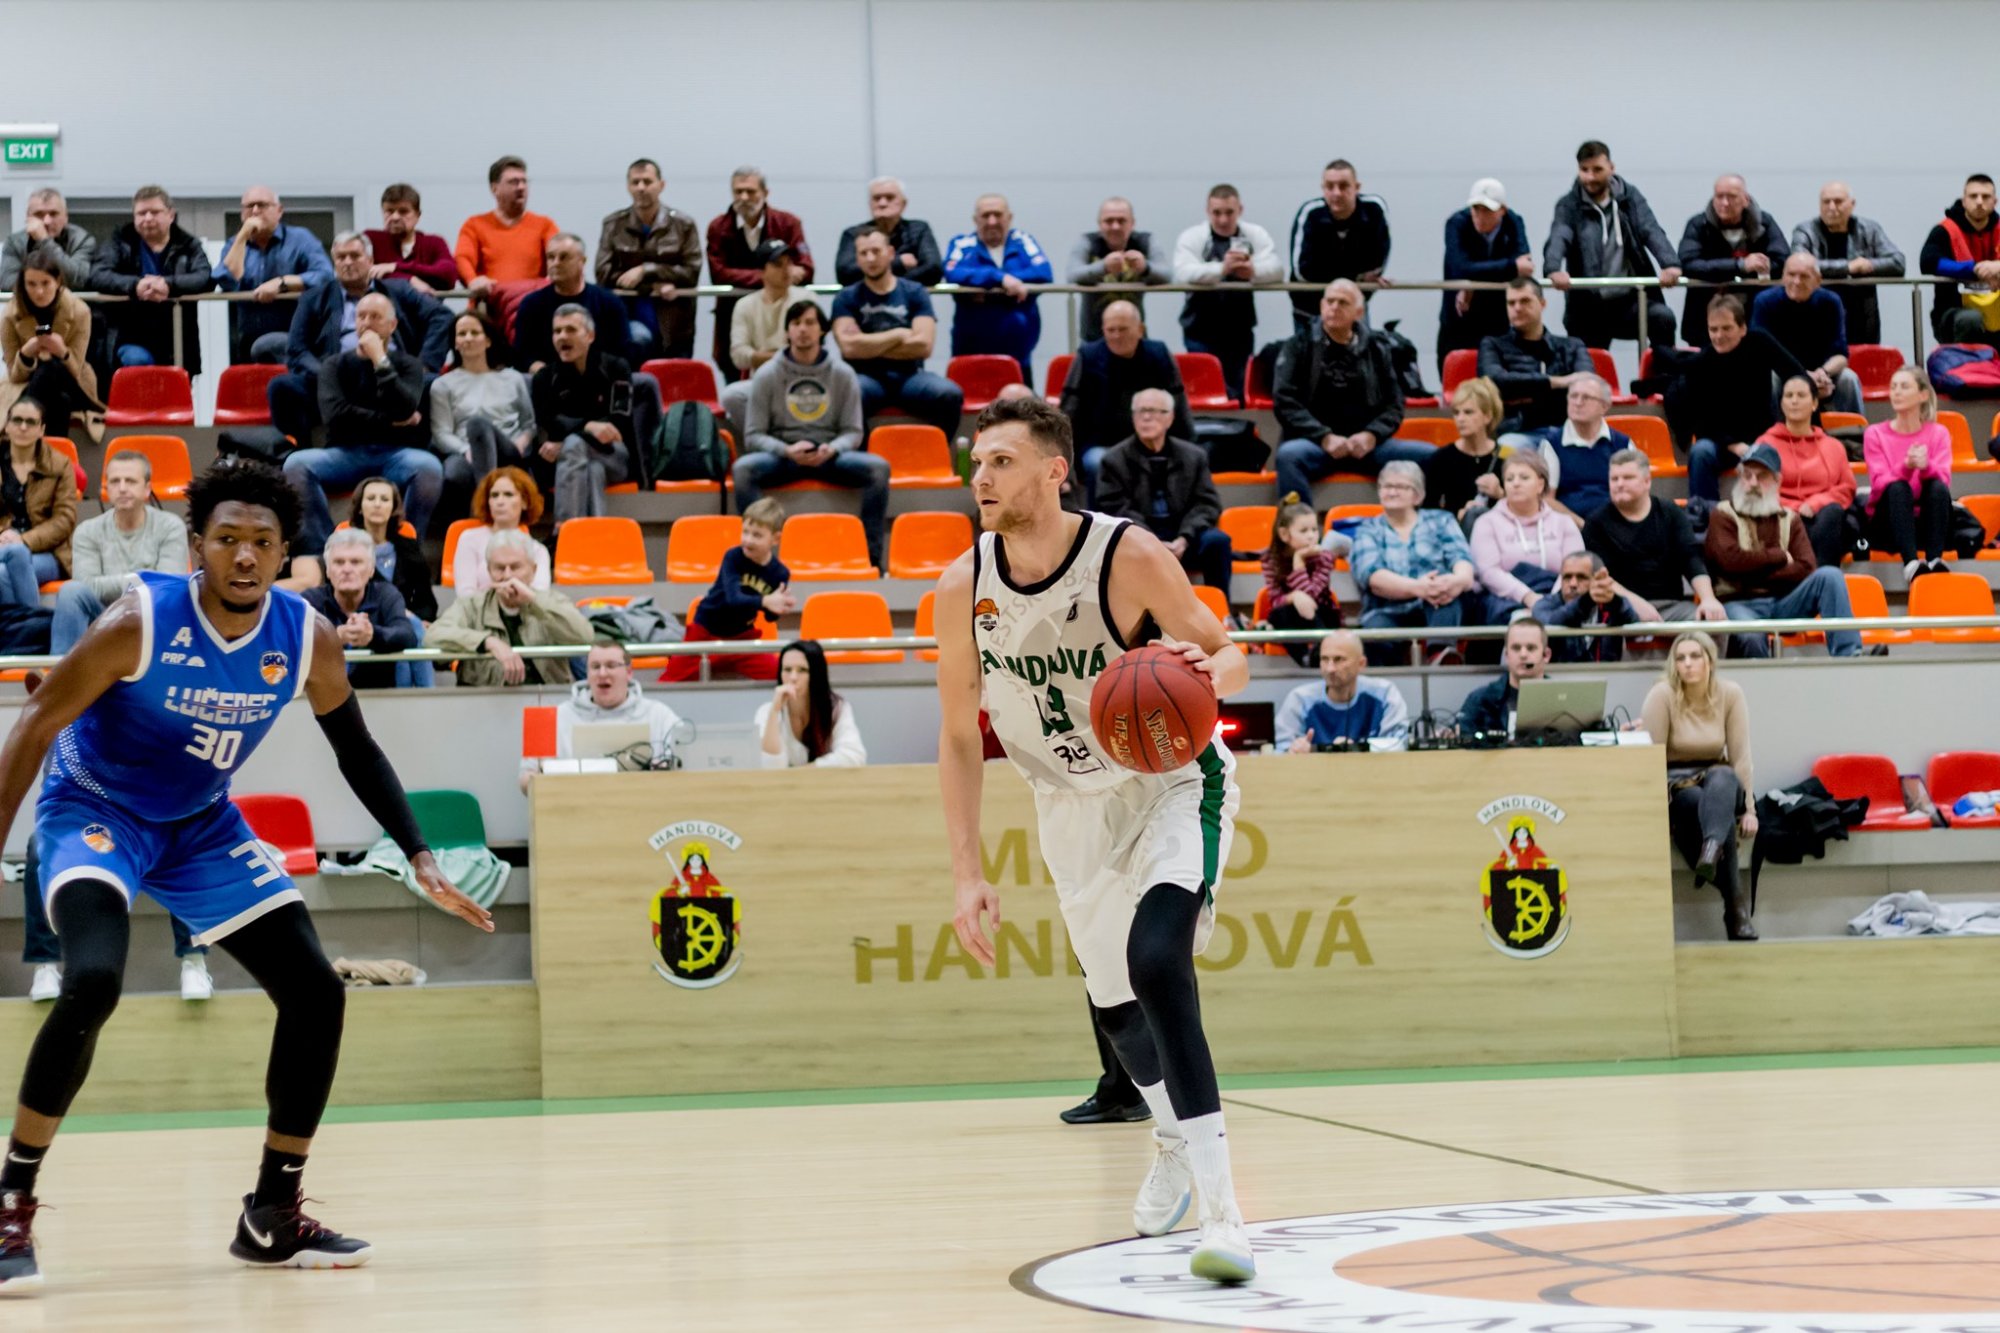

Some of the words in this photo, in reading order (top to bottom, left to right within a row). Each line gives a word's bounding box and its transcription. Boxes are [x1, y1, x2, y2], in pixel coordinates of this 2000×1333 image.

[8, 143, 48, 159] EXIT
[160, 651, 187, 665] PRP
[981, 642, 1107, 687] HNDLOVÁ
[163, 685, 278, 725] LUČENEC
[185, 722, 244, 770] 30
[852, 897, 1374, 985] HANOVÁ
